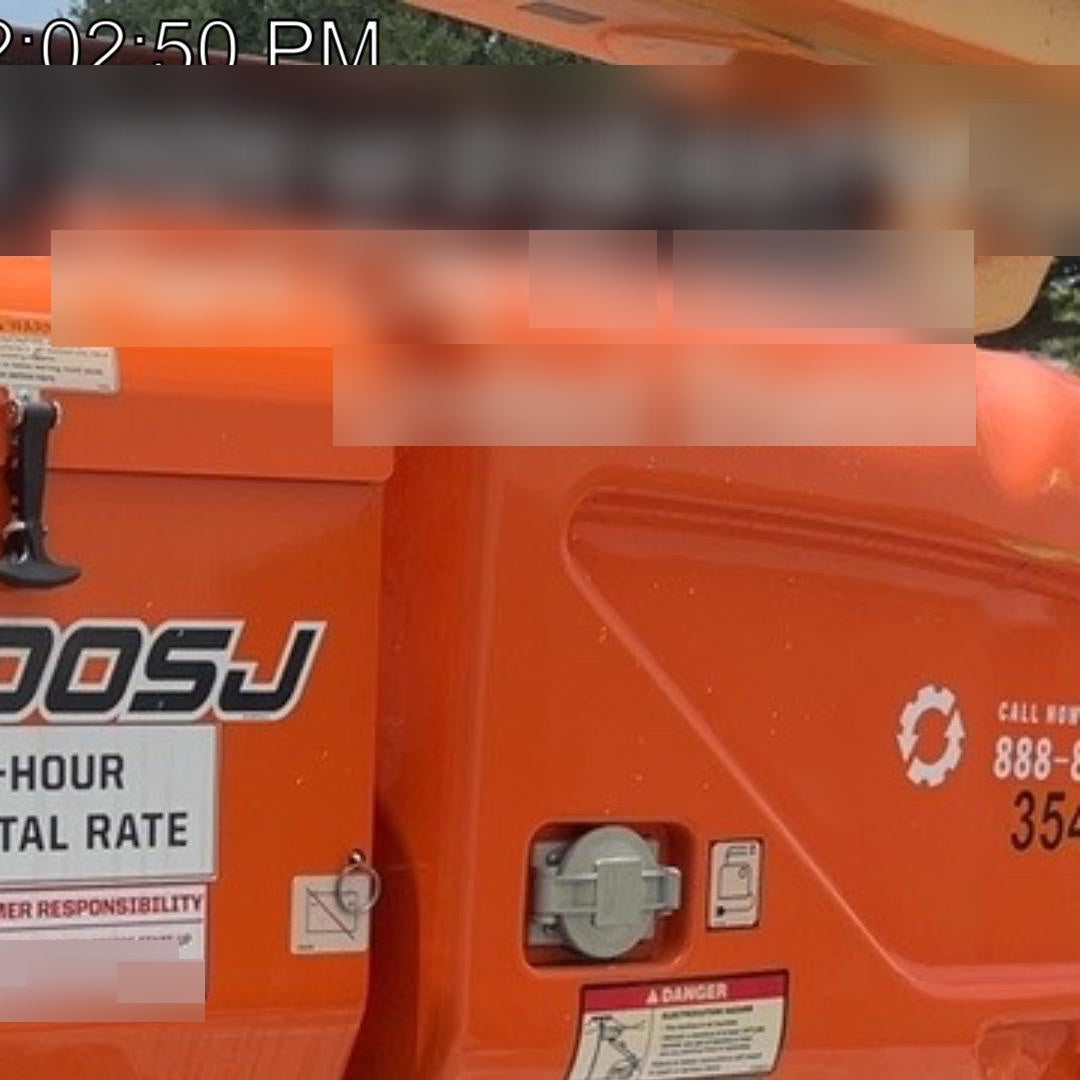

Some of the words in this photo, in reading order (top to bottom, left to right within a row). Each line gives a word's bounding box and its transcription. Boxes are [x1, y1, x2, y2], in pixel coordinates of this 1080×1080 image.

[998, 701, 1039, 724] CALL
[85, 812, 188, 850] RATE
[37, 894, 202, 918] RESPONSIBILITY
[661, 983, 727, 1003] DANGER
